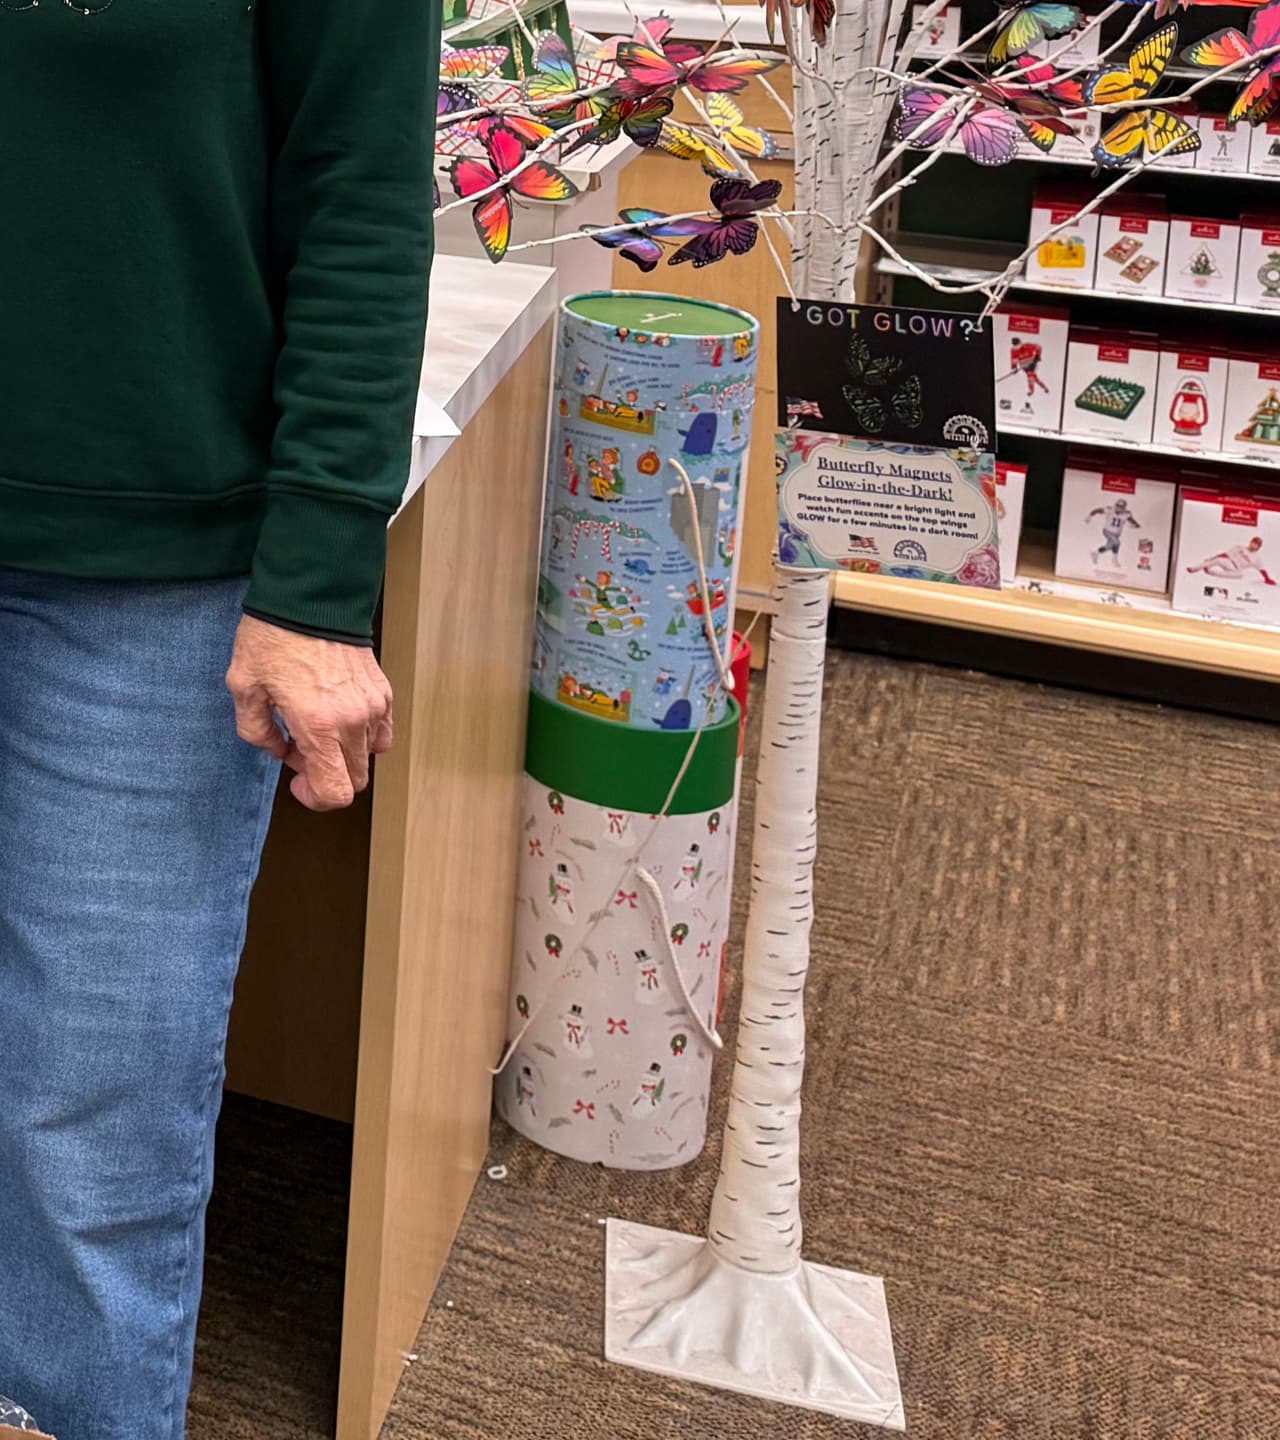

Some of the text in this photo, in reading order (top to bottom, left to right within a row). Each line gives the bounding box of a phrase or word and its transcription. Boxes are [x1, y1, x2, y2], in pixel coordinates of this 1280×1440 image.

[806, 306, 859, 329] GOT
[818, 457, 951, 482] Butterfly Magnets
[818, 474, 953, 501] Glow-in-the-Dark!
[798, 493, 822, 501] Place
[824, 496, 871, 507] butterflies
[904, 504, 933, 514] bright
[934, 508, 956, 517] light
[958, 512, 976, 520] and
[806, 505, 834, 513] watch
[836, 507, 852, 515] fun
[854, 510, 889, 519] accents
[905, 514, 920, 522] the
[922, 516, 938, 525] top
[940, 519, 968, 529] wings
[797, 512, 825, 522] GLOW
[827, 515, 840, 523] for
[851, 518, 867, 526] few
[869, 520, 906, 530] minutes
[908, 524, 918, 532] in
[928, 528, 949, 537] dark
[951, 531, 979, 540] room!
